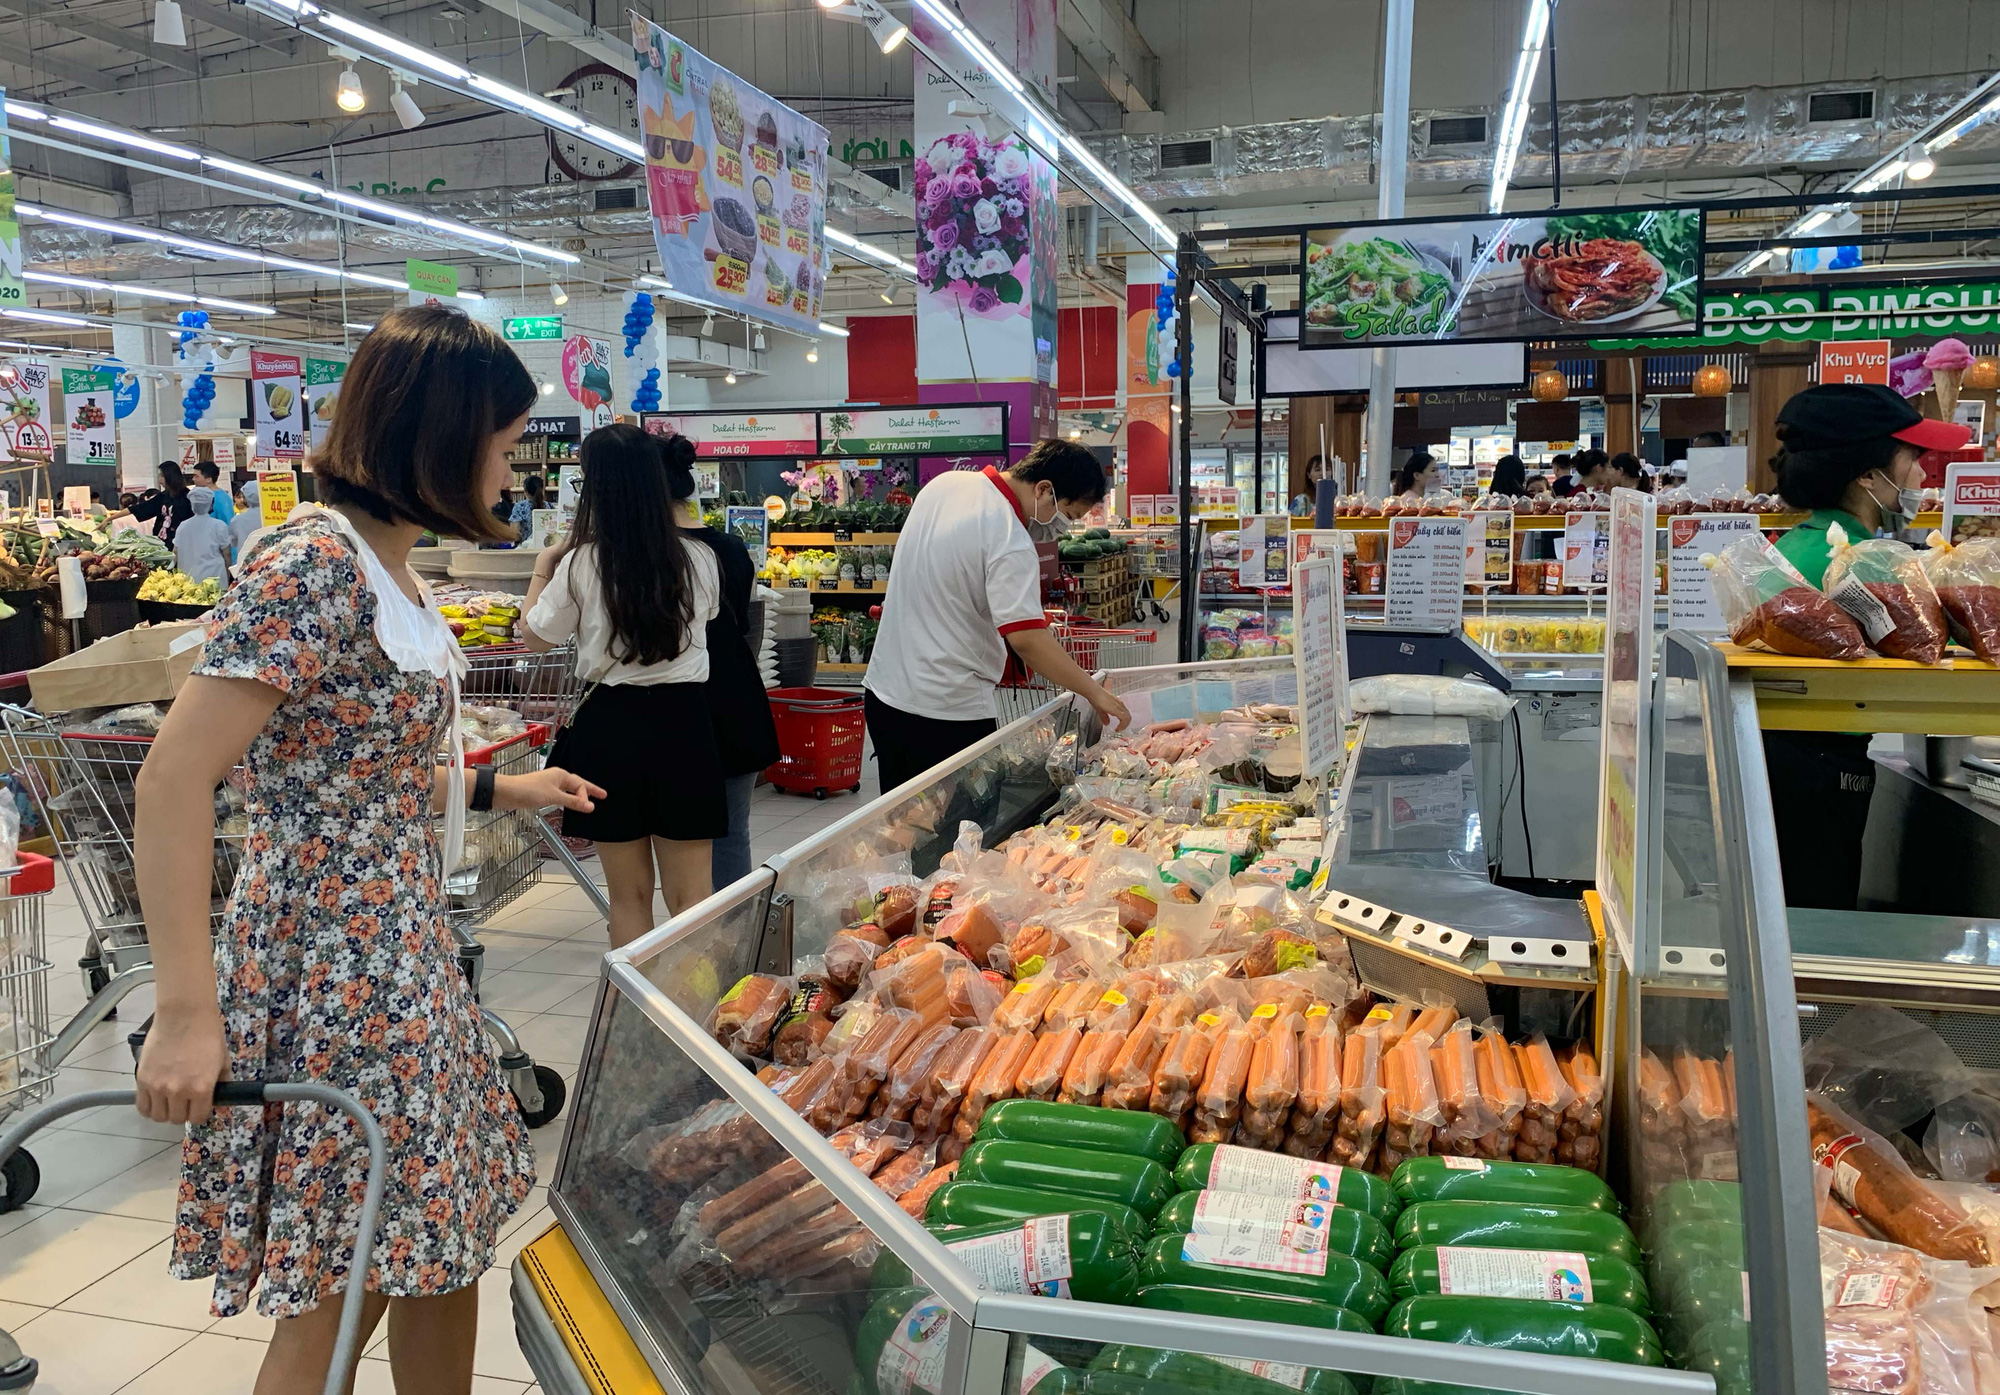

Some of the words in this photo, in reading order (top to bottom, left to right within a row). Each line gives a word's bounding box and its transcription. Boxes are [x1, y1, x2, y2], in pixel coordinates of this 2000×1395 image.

[592, 80, 603, 91] 12
[613, 86, 618, 95] 1
[625, 99, 633, 109] 2
[631, 117, 638, 128] 3
[567, 143, 575, 154] 8
[581, 156, 588, 166] 7
[598, 159, 605, 169] 6
[755, 153, 767, 172] 28
[716, 156, 733, 181] 54
[759, 224, 770, 242] 30
[716, 267, 732, 288] 25
[541, 329, 557, 337] EXIT
[1825, 353, 1852, 367] Khu
[1856, 352, 1886, 368] Vực
[314, 363, 328, 374] Best
[71, 373, 88, 383] Best
[311, 372, 331, 383] Seller
[68, 382, 91, 393] Seller
[598, 414, 603, 425] 9
[888, 417, 915, 428] Dalat
[918, 416, 959, 428] Hasfarm
[540, 422, 566, 435] HẠT
[712, 422, 736, 434] Dalat
[738, 422, 775, 434] Hasfarm
[22, 433, 32, 446] 13
[274, 430, 290, 448] 64
[291, 434, 302, 445] 900
[89, 441, 102, 458] 31
[104, 442, 115, 454] 900
[713, 446, 732, 454] HOA
[733, 444, 749, 454] GÓI
[869, 441, 885, 451] CÂY
[887, 441, 916, 451] TRANG
[917, 439, 931, 450] TRÍ
[1548, 443, 1563, 451] 219
[271, 500, 282, 513] 44
[1693, 520, 1715, 533] Quầy
